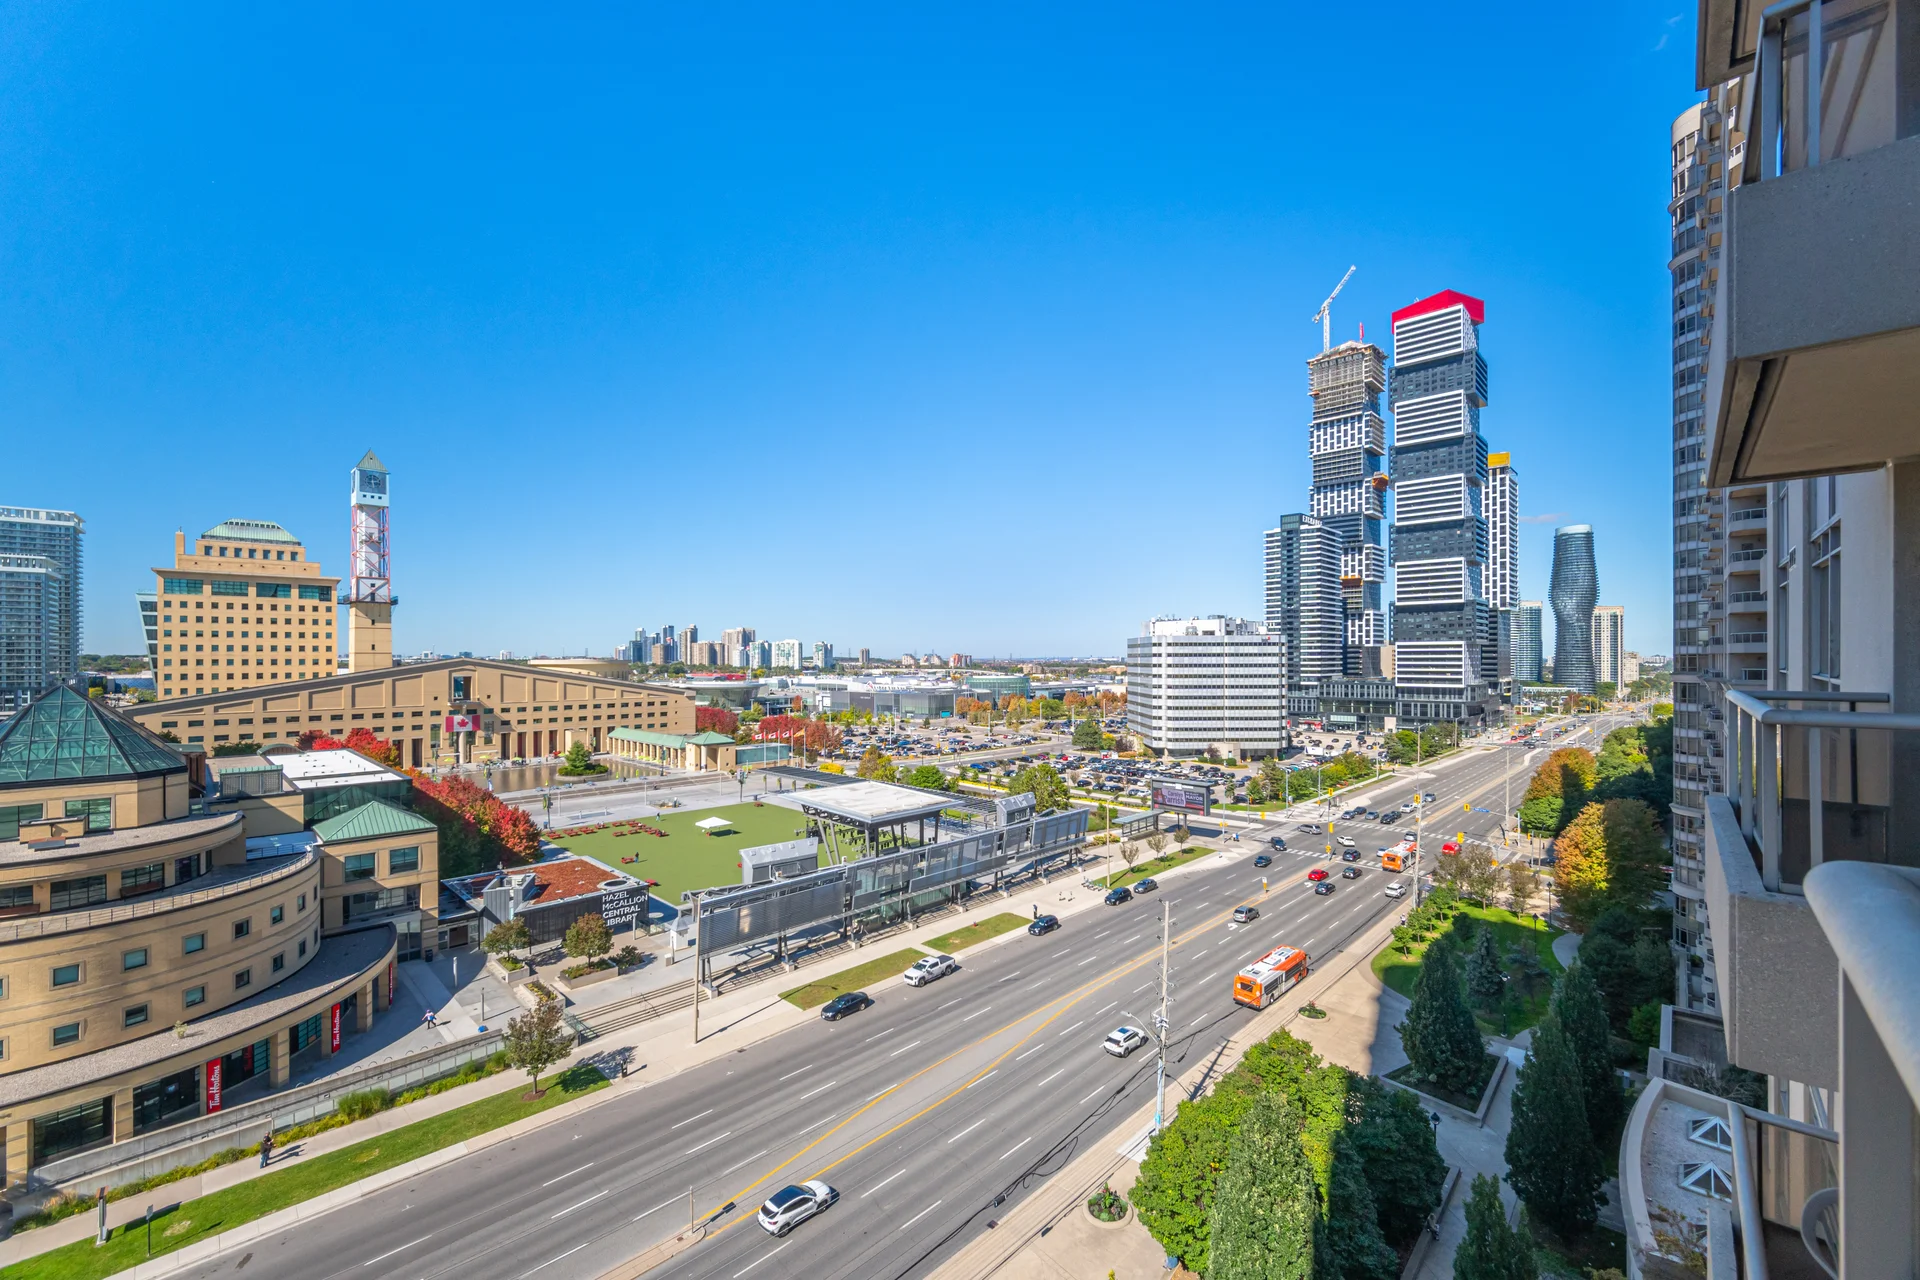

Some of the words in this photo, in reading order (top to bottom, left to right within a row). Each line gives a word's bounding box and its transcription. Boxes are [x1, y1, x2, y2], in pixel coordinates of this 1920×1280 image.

[602, 891, 630, 903] HAZEL
[602, 894, 648, 910] McCALLION
[602, 904, 641, 919] CENTRAL
[209, 1065, 220, 1093] Hortons
[209, 1094, 220, 1109] Tim
